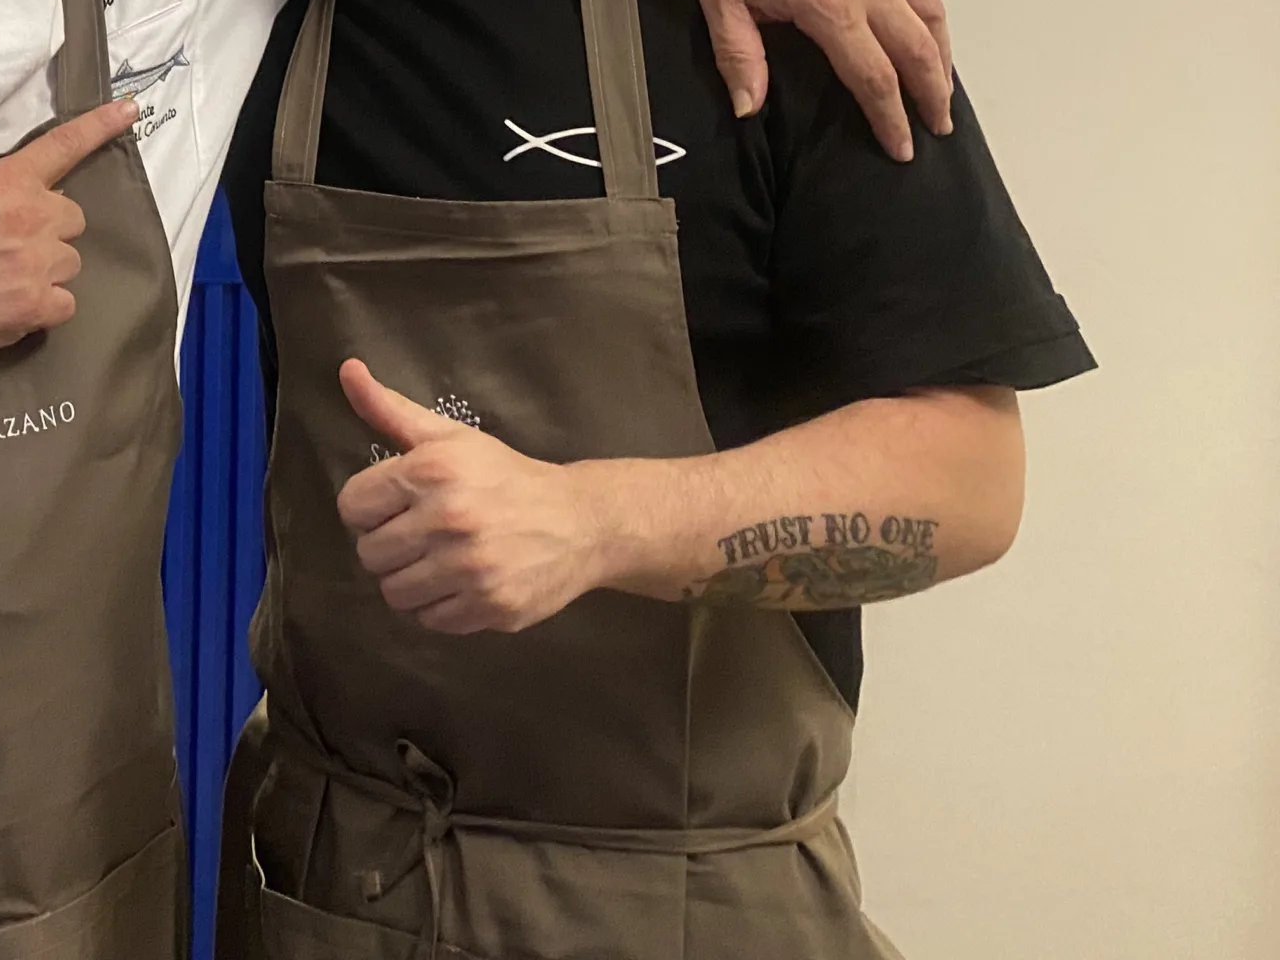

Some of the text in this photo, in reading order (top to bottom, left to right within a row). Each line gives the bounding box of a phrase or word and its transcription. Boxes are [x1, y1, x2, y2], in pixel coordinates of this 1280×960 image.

[717, 512, 940, 566] TRUST NO ONE
